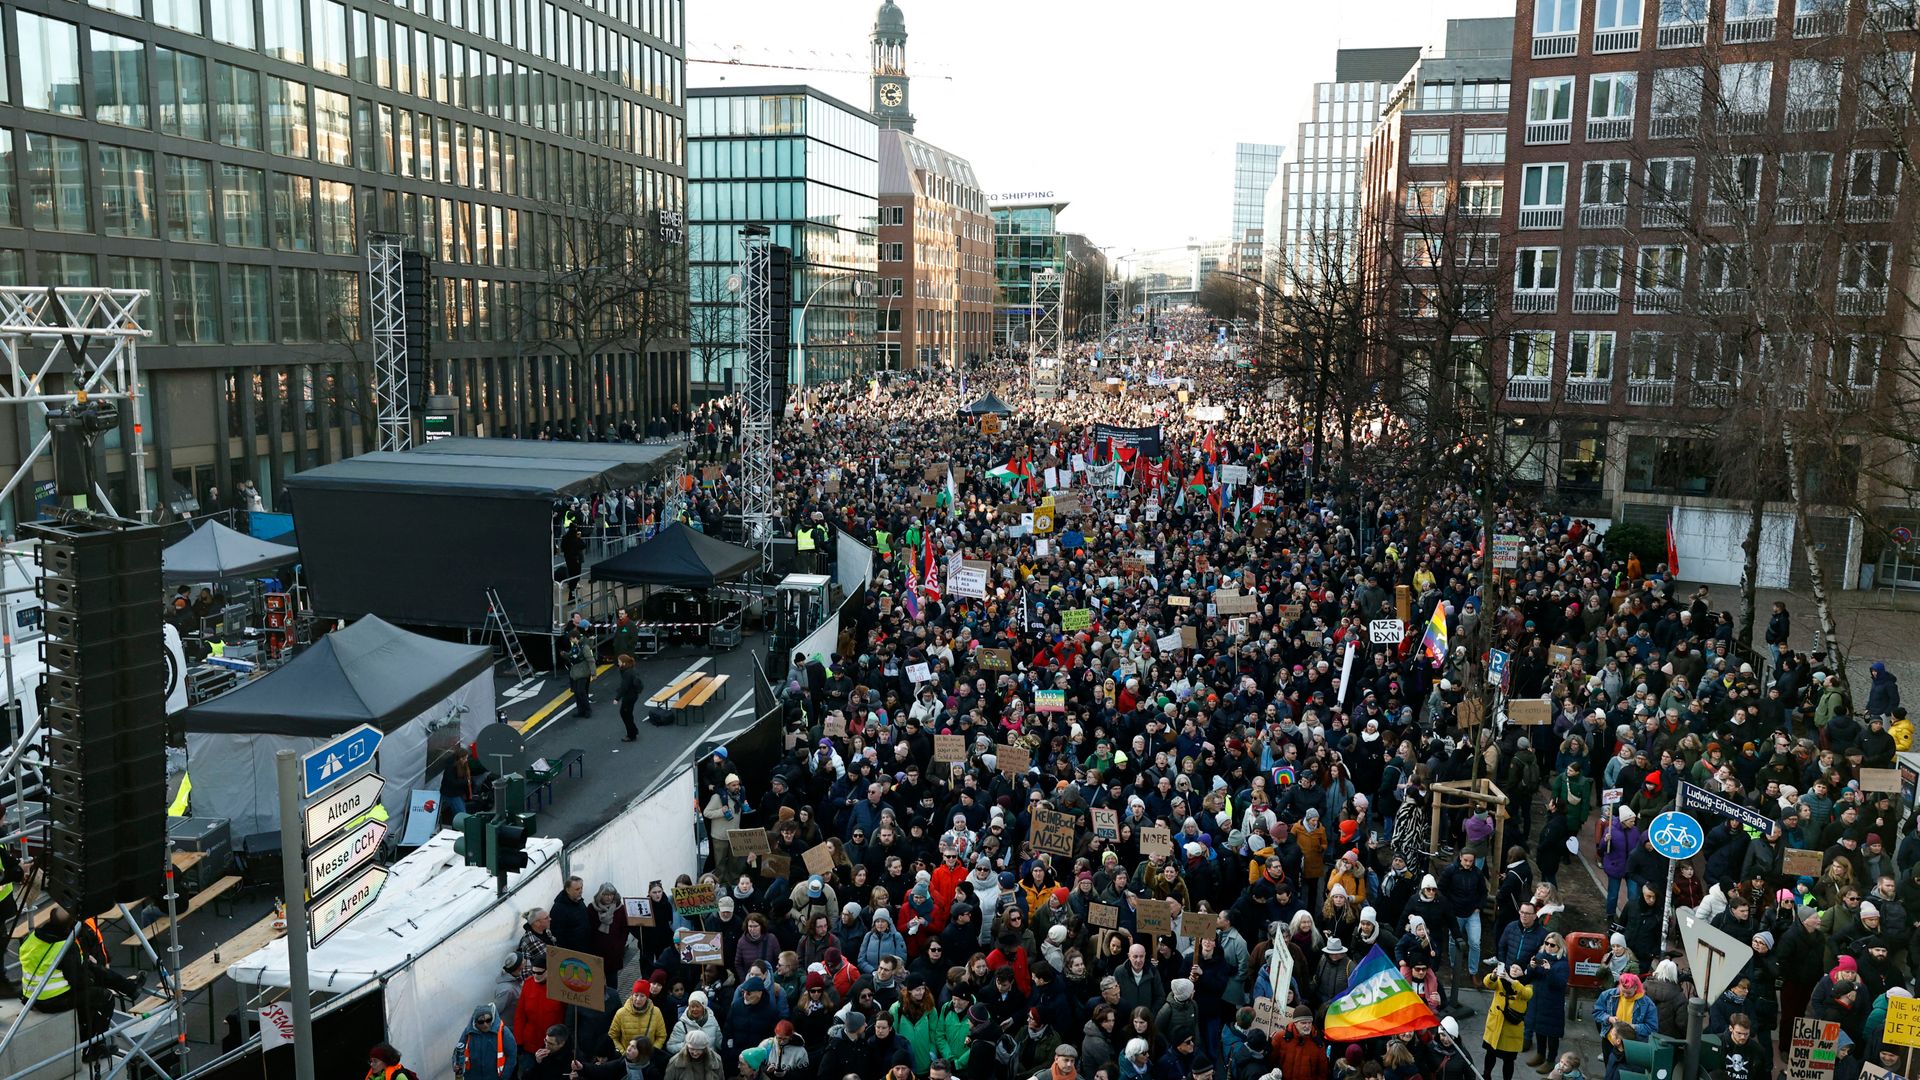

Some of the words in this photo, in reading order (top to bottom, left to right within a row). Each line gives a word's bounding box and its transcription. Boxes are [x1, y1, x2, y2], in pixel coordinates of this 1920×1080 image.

[1002, 191, 1055, 201] SHIPPING
[1372, 621, 1397, 630] NZS
[1374, 631, 1400, 642] BXN
[354, 744, 360, 755] 7
[328, 795, 361, 823] Altona
[1686, 786, 1767, 830] Ludwig-Erhard-Straße
[1094, 812, 1115, 824] FCK
[1043, 825, 1060, 834] AUF
[1098, 829, 1115, 838] NZS
[1143, 833, 1168, 845] NOPE
[316, 829, 375, 881] Messe/CCH
[340, 885, 370, 915] Arena
[561, 989, 592, 1005] PEACE
[1890, 1001, 1907, 1011] NIE
[1818, 1040, 1834, 1050] AUF
[1794, 1048, 1810, 1059] DEN
[1790, 1058, 1806, 1069] WO
[1790, 1069, 1824, 1080] WOHNT
